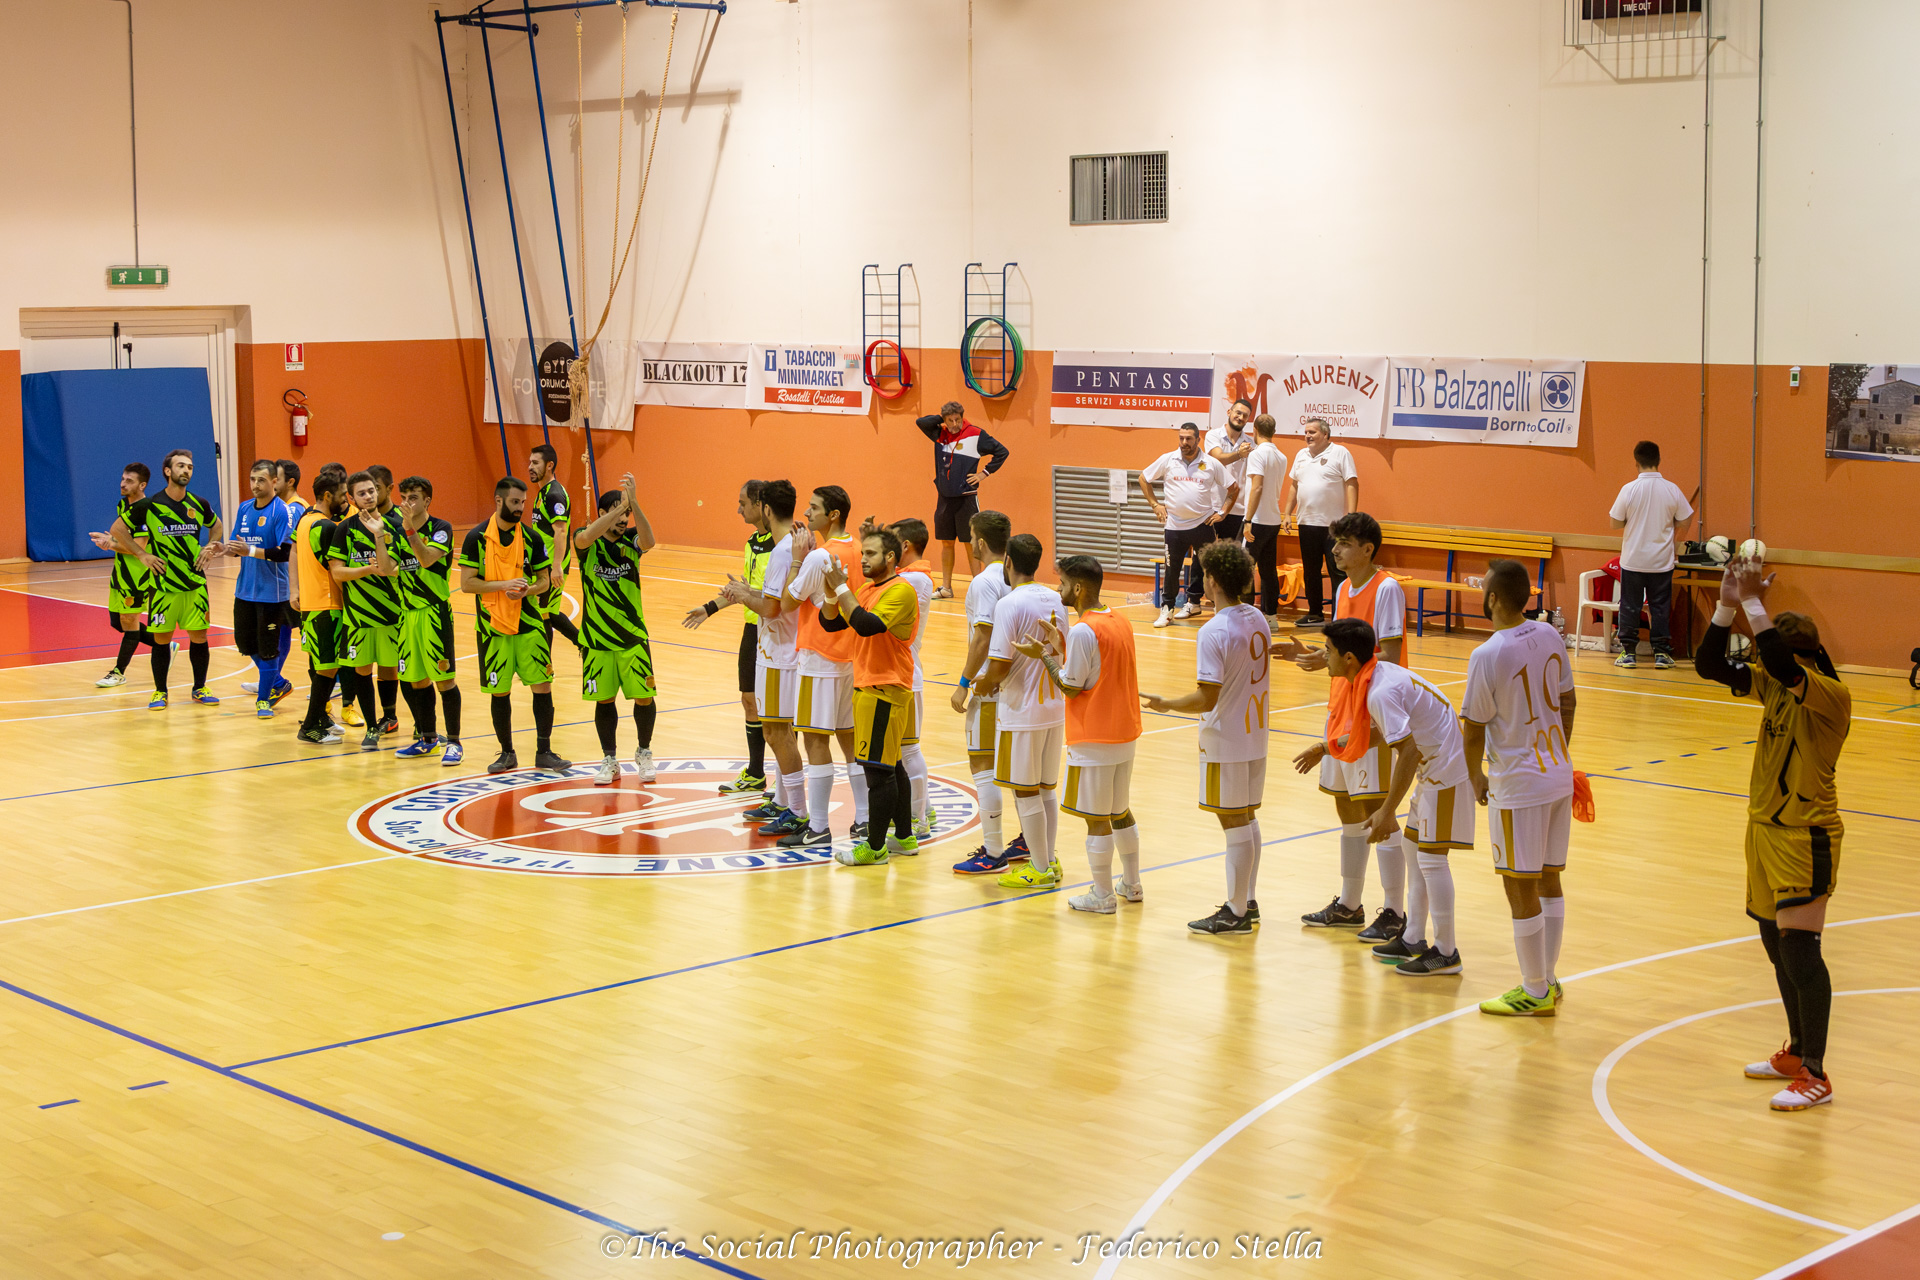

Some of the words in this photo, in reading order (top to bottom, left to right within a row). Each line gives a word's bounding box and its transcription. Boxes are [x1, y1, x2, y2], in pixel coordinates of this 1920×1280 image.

[1622, 4, 1638, 12] TIME
[1638, 2, 1652, 11] OUT
[785, 350, 836, 367] TABACCHI
[643, 362, 726, 383] BLACKOUT
[733, 365, 747, 383] 17
[778, 369, 844, 387] MINIMARKET
[1076, 370, 1190, 391] PENTASS
[1283, 364, 1379, 400] MAURENZI
[1393, 367, 1426, 408] FB
[1434, 369, 1532, 412] Balzanelli
[777, 389, 811, 402] Rosatelli
[813, 390, 845, 405] Cristian
[1075, 396, 1112, 406] SERVIZI
[1119, 398, 1189, 409] ASSICURATIVI
[1304, 403, 1356, 415] MACELLERIA
[1299, 415, 1359, 428] GRONOMIA
[153, 612, 166, 625] 14
[349, 645, 358, 659] 5
[1249, 630, 1269, 685] 9
[489, 672, 498, 686] 9
[587, 680, 598, 693] 11
[1512, 652, 1563, 725] 10
[858, 740, 868, 757] 2
[1358, 769, 1369, 789] 2
[385, 820, 423, 838] Soc.
